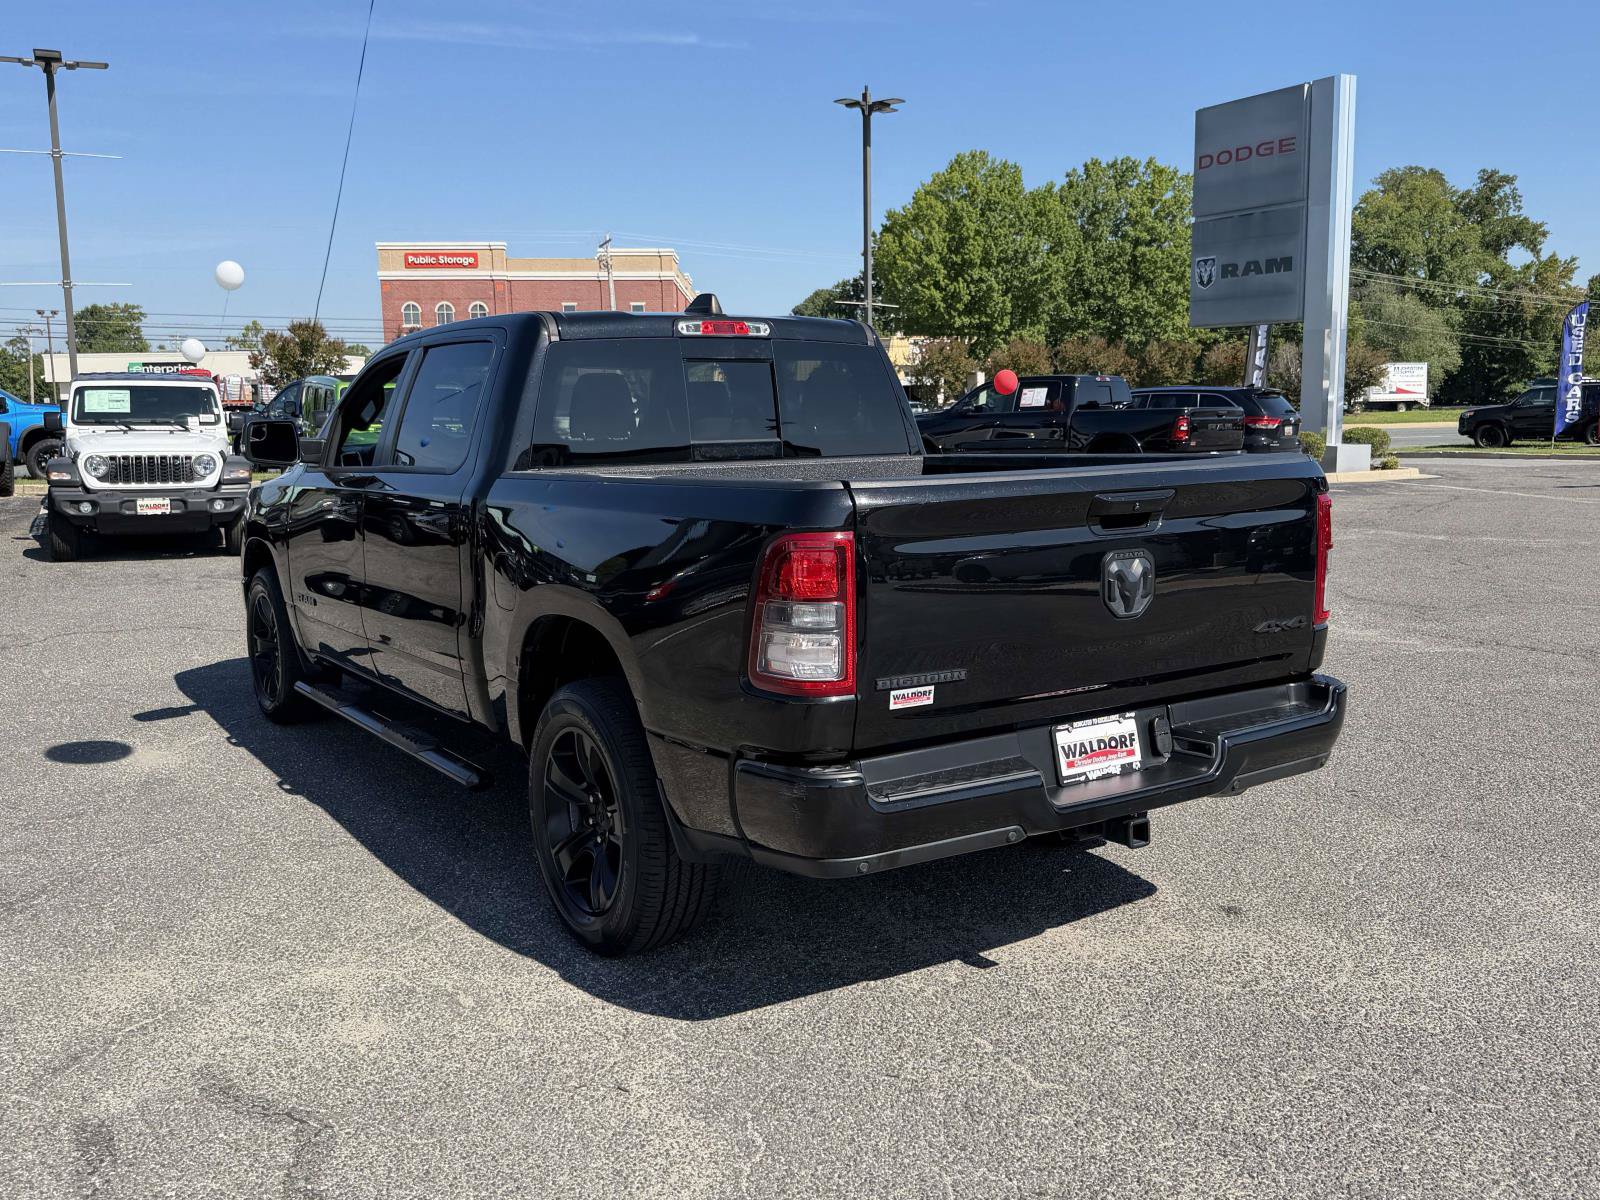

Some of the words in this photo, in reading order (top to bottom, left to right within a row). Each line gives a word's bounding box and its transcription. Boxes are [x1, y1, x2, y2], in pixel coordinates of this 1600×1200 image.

[1198, 136, 1297, 170] DODGE
[407, 255, 437, 264] Public
[438, 255, 475, 266] Storage
[1220, 255, 1293, 280] RAM
[1568, 313, 1586, 366] USED
[1564, 372, 1583, 423] CARS
[1115, 551, 1145, 559] RAM
[875, 669, 968, 691] BIGHORN
[892, 689, 933, 702] WALDORF
[1060, 732, 1136, 760] WALDORF
[1092, 755, 1107, 764] Dodge
